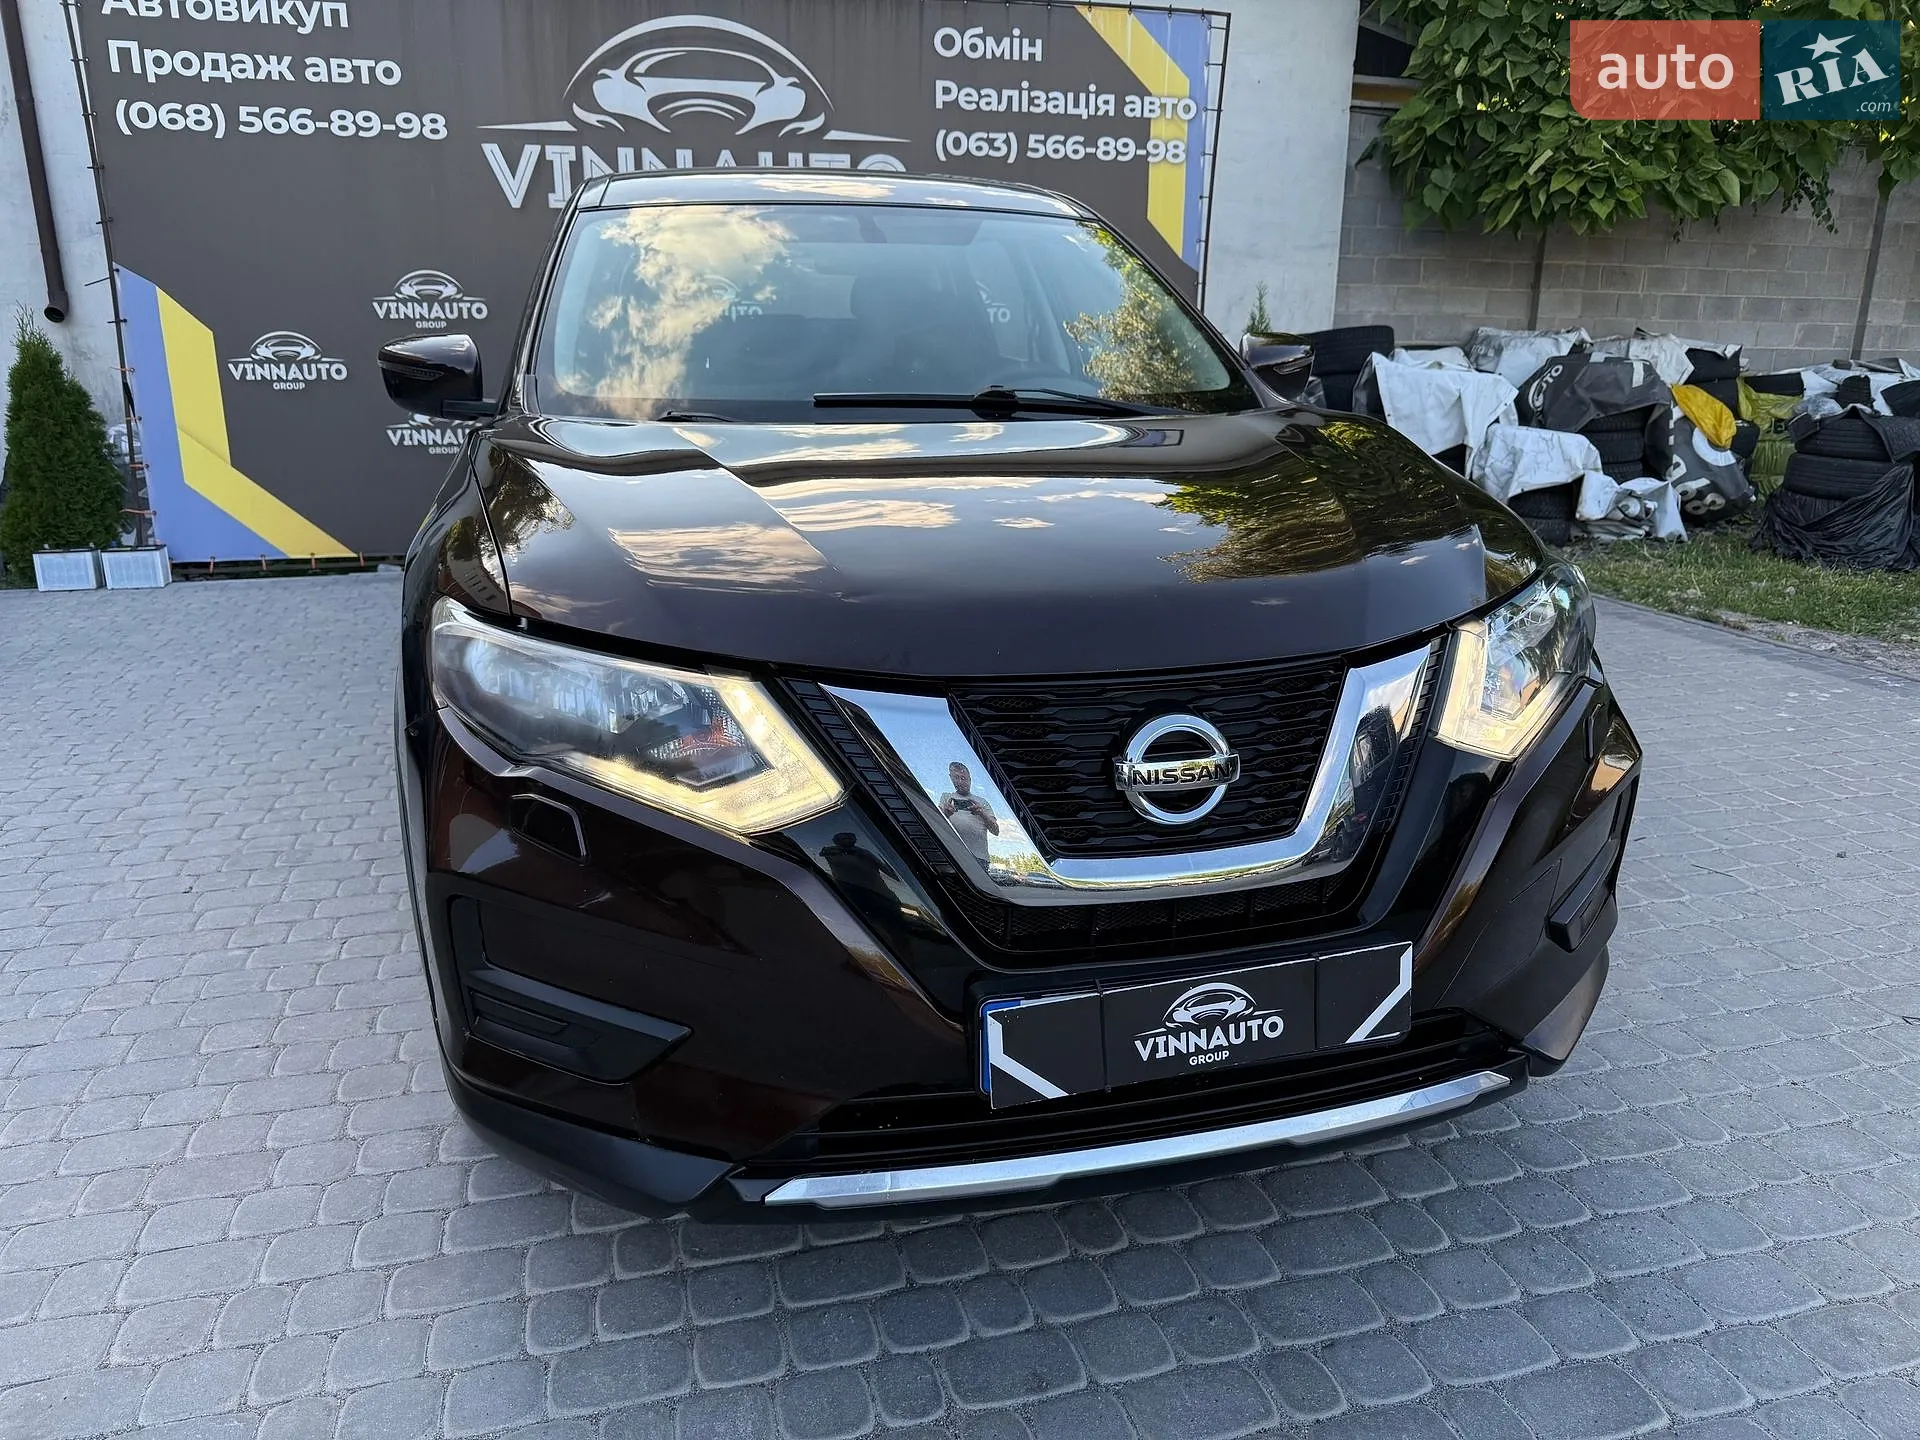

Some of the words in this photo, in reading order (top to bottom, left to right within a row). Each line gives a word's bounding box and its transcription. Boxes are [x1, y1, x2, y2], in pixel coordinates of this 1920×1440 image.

[933, 27, 1043, 62] Обмін
[107, 39, 296, 84] Продаж
[304, 56, 402, 86] авто
[935, 79, 1116, 120] Реалізація
[1123, 93, 1198, 121] авто
[115, 99, 226, 139] (068)
[238, 105, 448, 141] 566-89-98
[935, 129, 1018, 164] (063)
[1026, 133, 1187, 164] 566-89-98
[372, 301, 488, 320] VINNAUTO
[415, 320, 447, 329] GROUP
[227, 362, 348, 381] VINNAUTO
[272, 382, 306, 391] GROUP
[386, 428, 471, 446] VINNAU
[1132, 761, 1231, 786] NISSAN
[1134, 1015, 1284, 1062] VINNAUTO
[1189, 1050, 1230, 1066] GROUP
